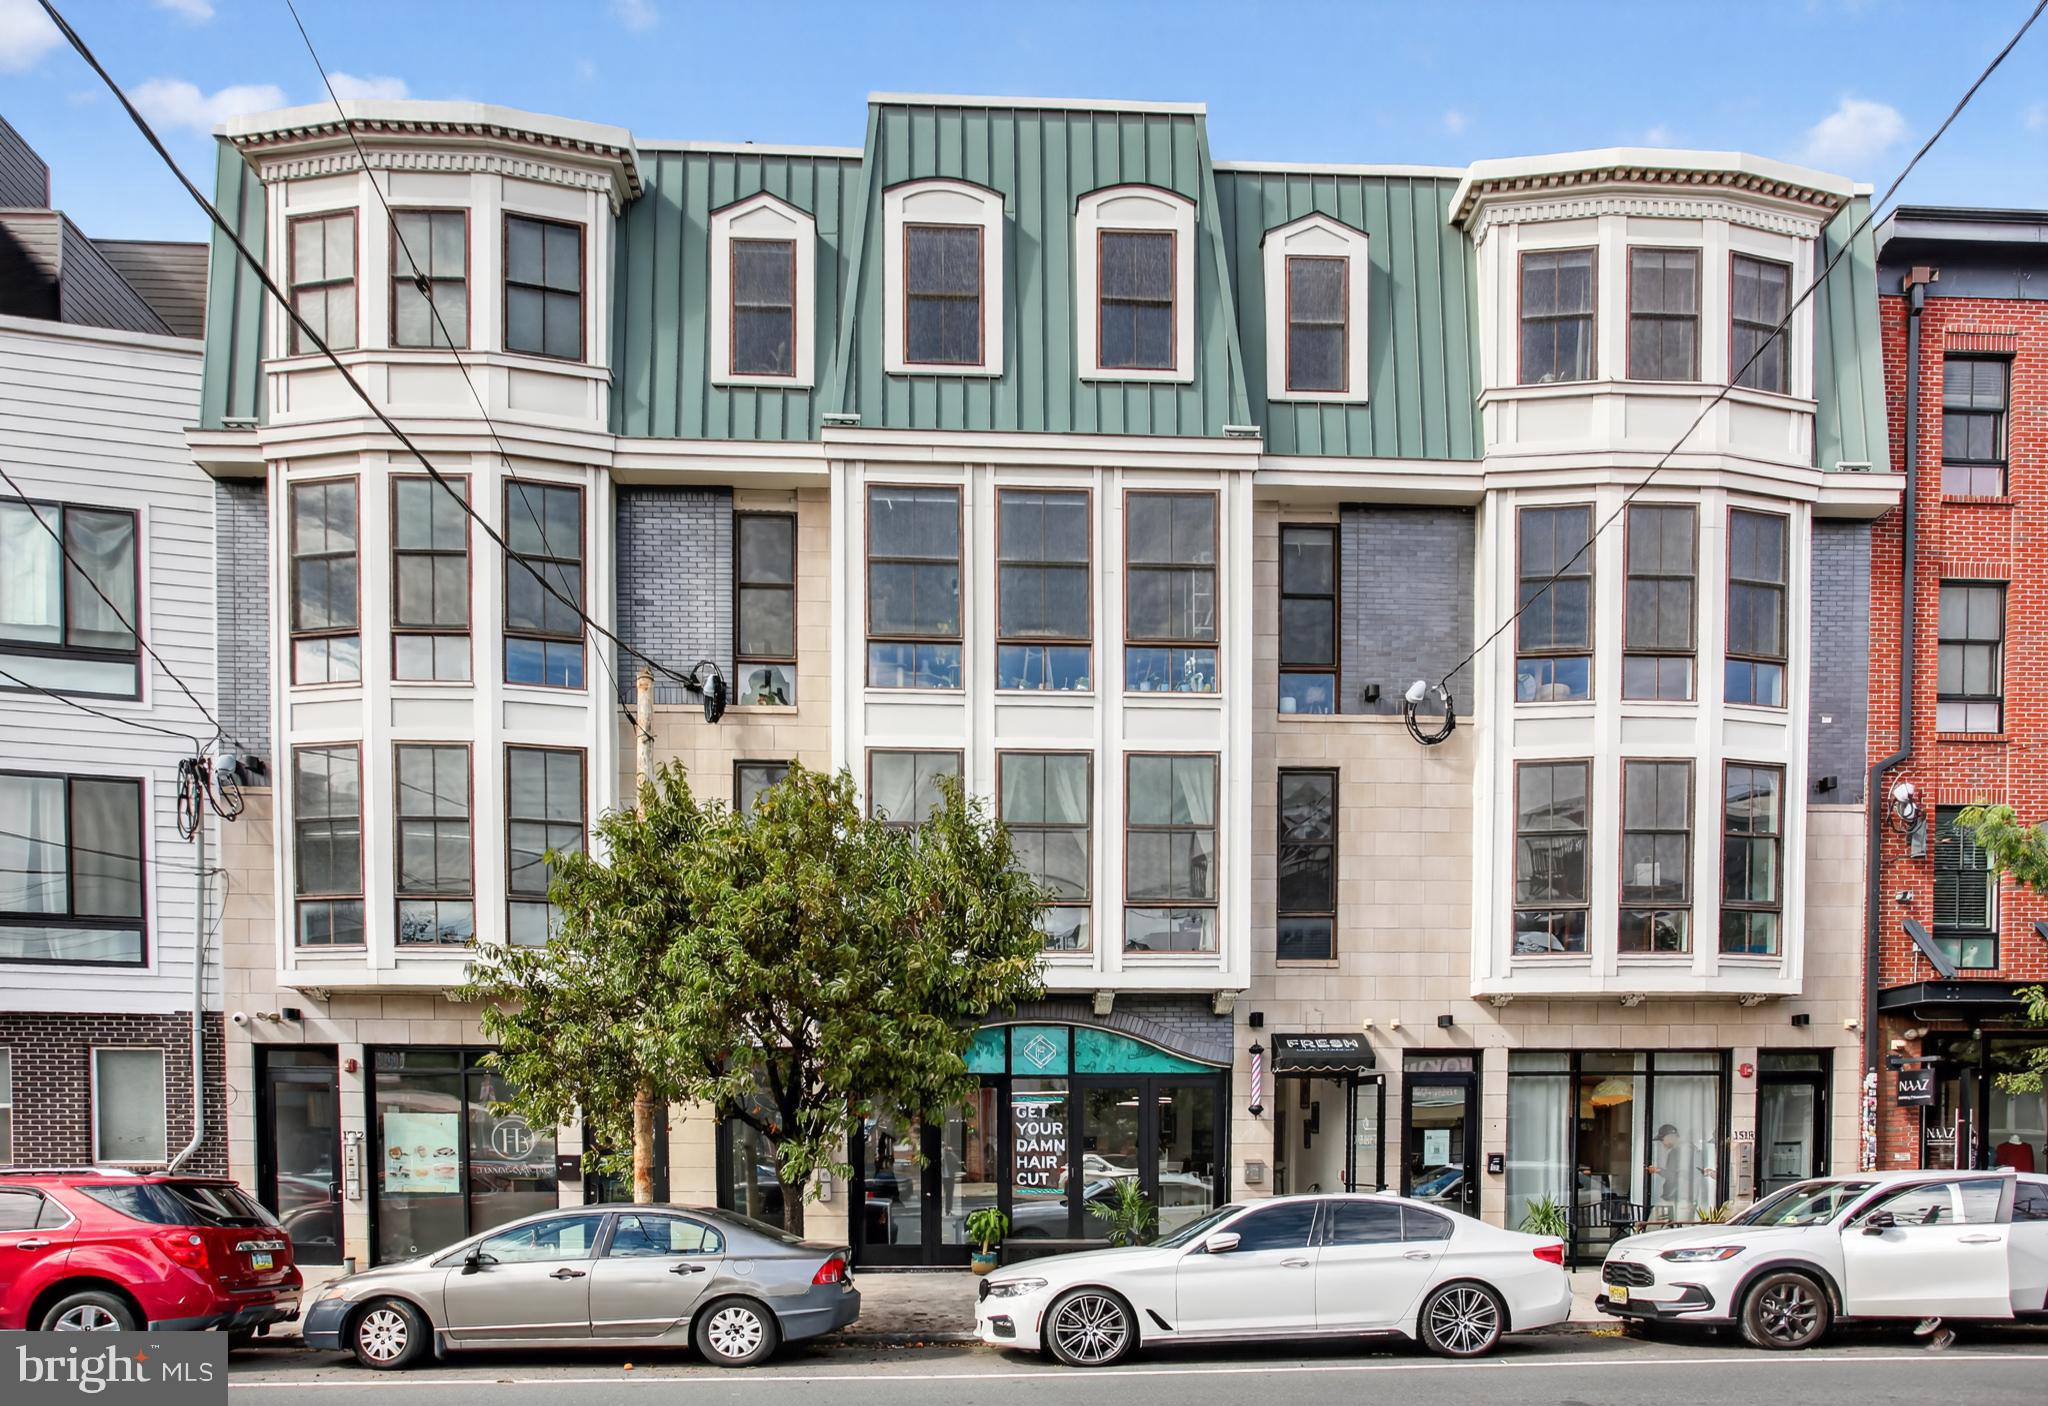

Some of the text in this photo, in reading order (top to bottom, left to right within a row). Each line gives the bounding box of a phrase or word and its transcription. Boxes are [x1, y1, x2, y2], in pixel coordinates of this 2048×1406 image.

[1286, 1039, 1359, 1049] FRESH
[1899, 1079, 1930, 1092] NAAZ
[1016, 1106, 1048, 1118] GET
[1016, 1122, 1064, 1135] YOUR
[1926, 1127, 1956, 1139] NAAZ
[1016, 1139, 1066, 1152] DAMN
[1016, 1156, 1058, 1169] HAIR
[1016, 1172, 1050, 1185] CUT
